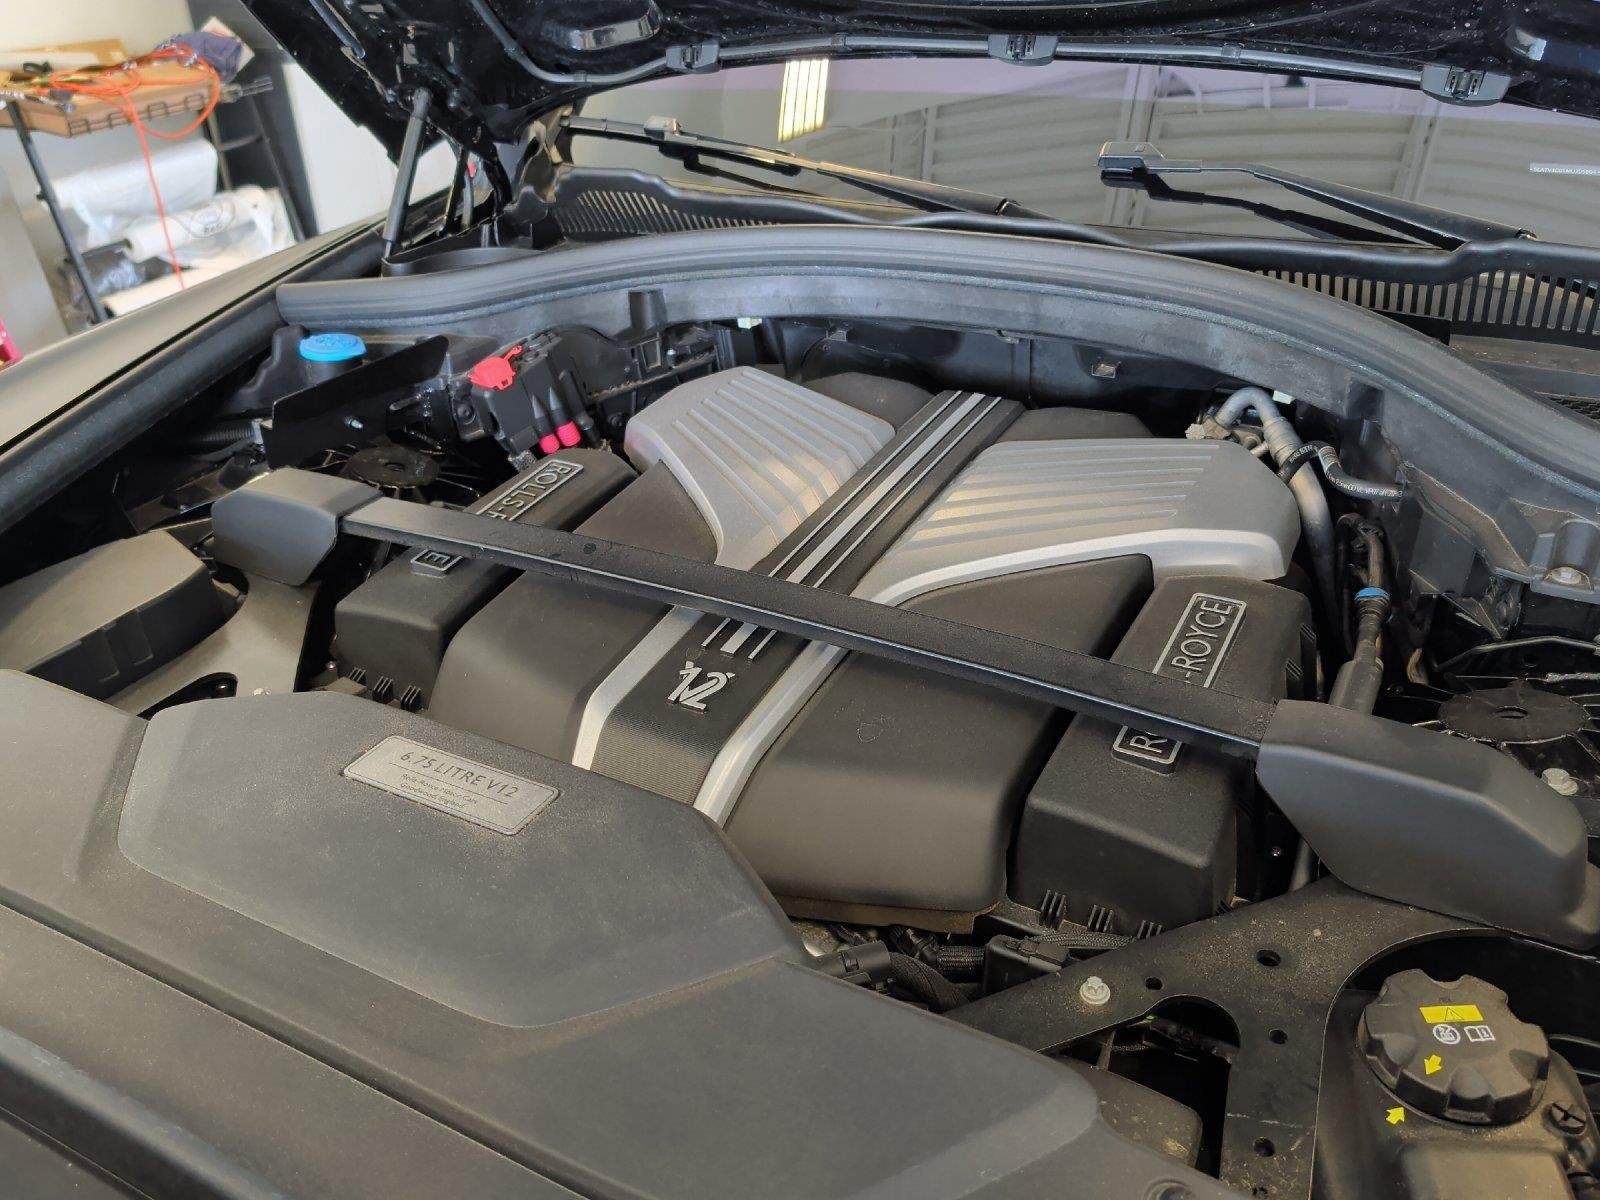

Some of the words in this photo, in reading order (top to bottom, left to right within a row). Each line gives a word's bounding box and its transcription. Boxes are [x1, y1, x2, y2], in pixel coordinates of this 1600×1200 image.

[1170, 600, 1233, 683] -ROYCE
[400, 751, 437, 769] 6.75
[435, 762, 487, 786] LITRE
[485, 778, 519, 798] V12
